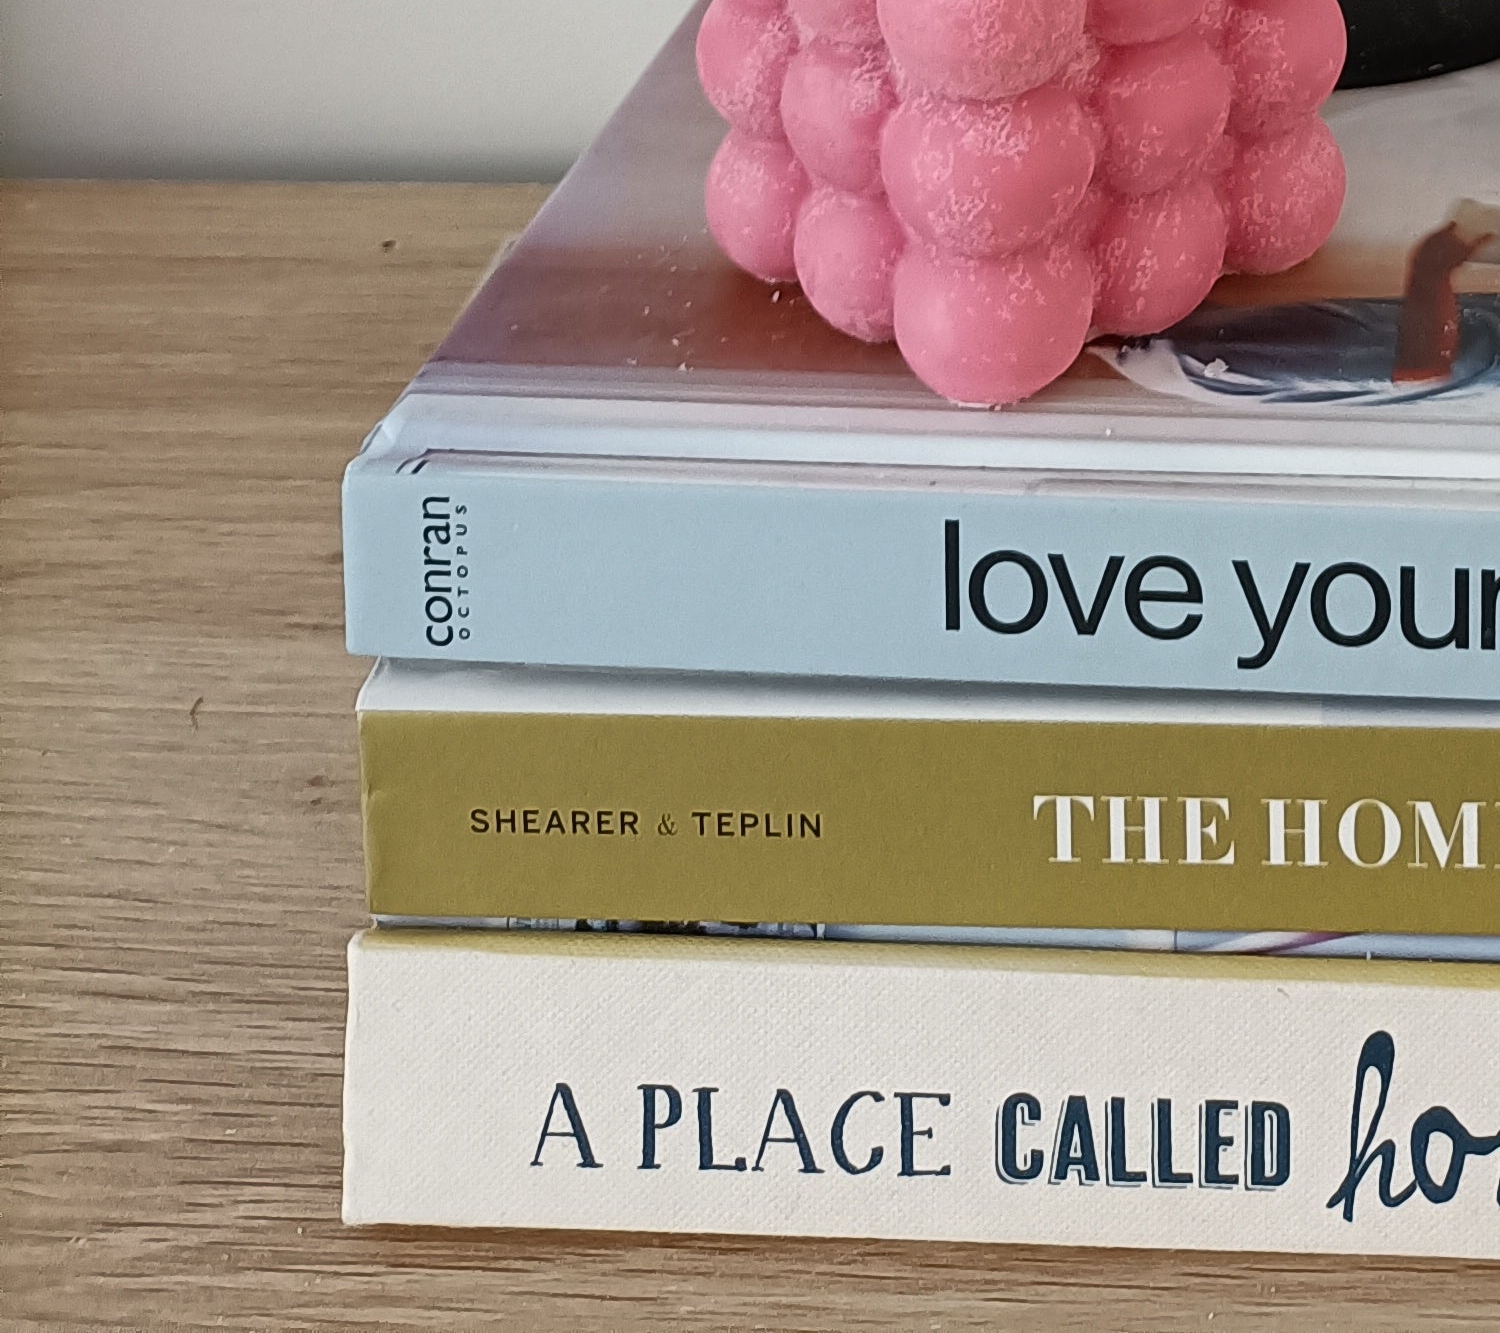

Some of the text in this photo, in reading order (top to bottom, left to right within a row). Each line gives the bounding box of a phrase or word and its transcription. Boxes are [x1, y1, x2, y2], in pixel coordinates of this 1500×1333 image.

[422, 496, 454, 647] conran
[457, 504, 471, 641] OCTOPUS
[944, 519, 1204, 641] love
[470, 808, 821, 838] SHEARER & TEPLIN
[1033, 795, 1235, 865] THE
[529, 1082, 604, 1169] A
[636, 1083, 952, 1178] PLACE
[994, 1092, 1291, 1192] CALLED
